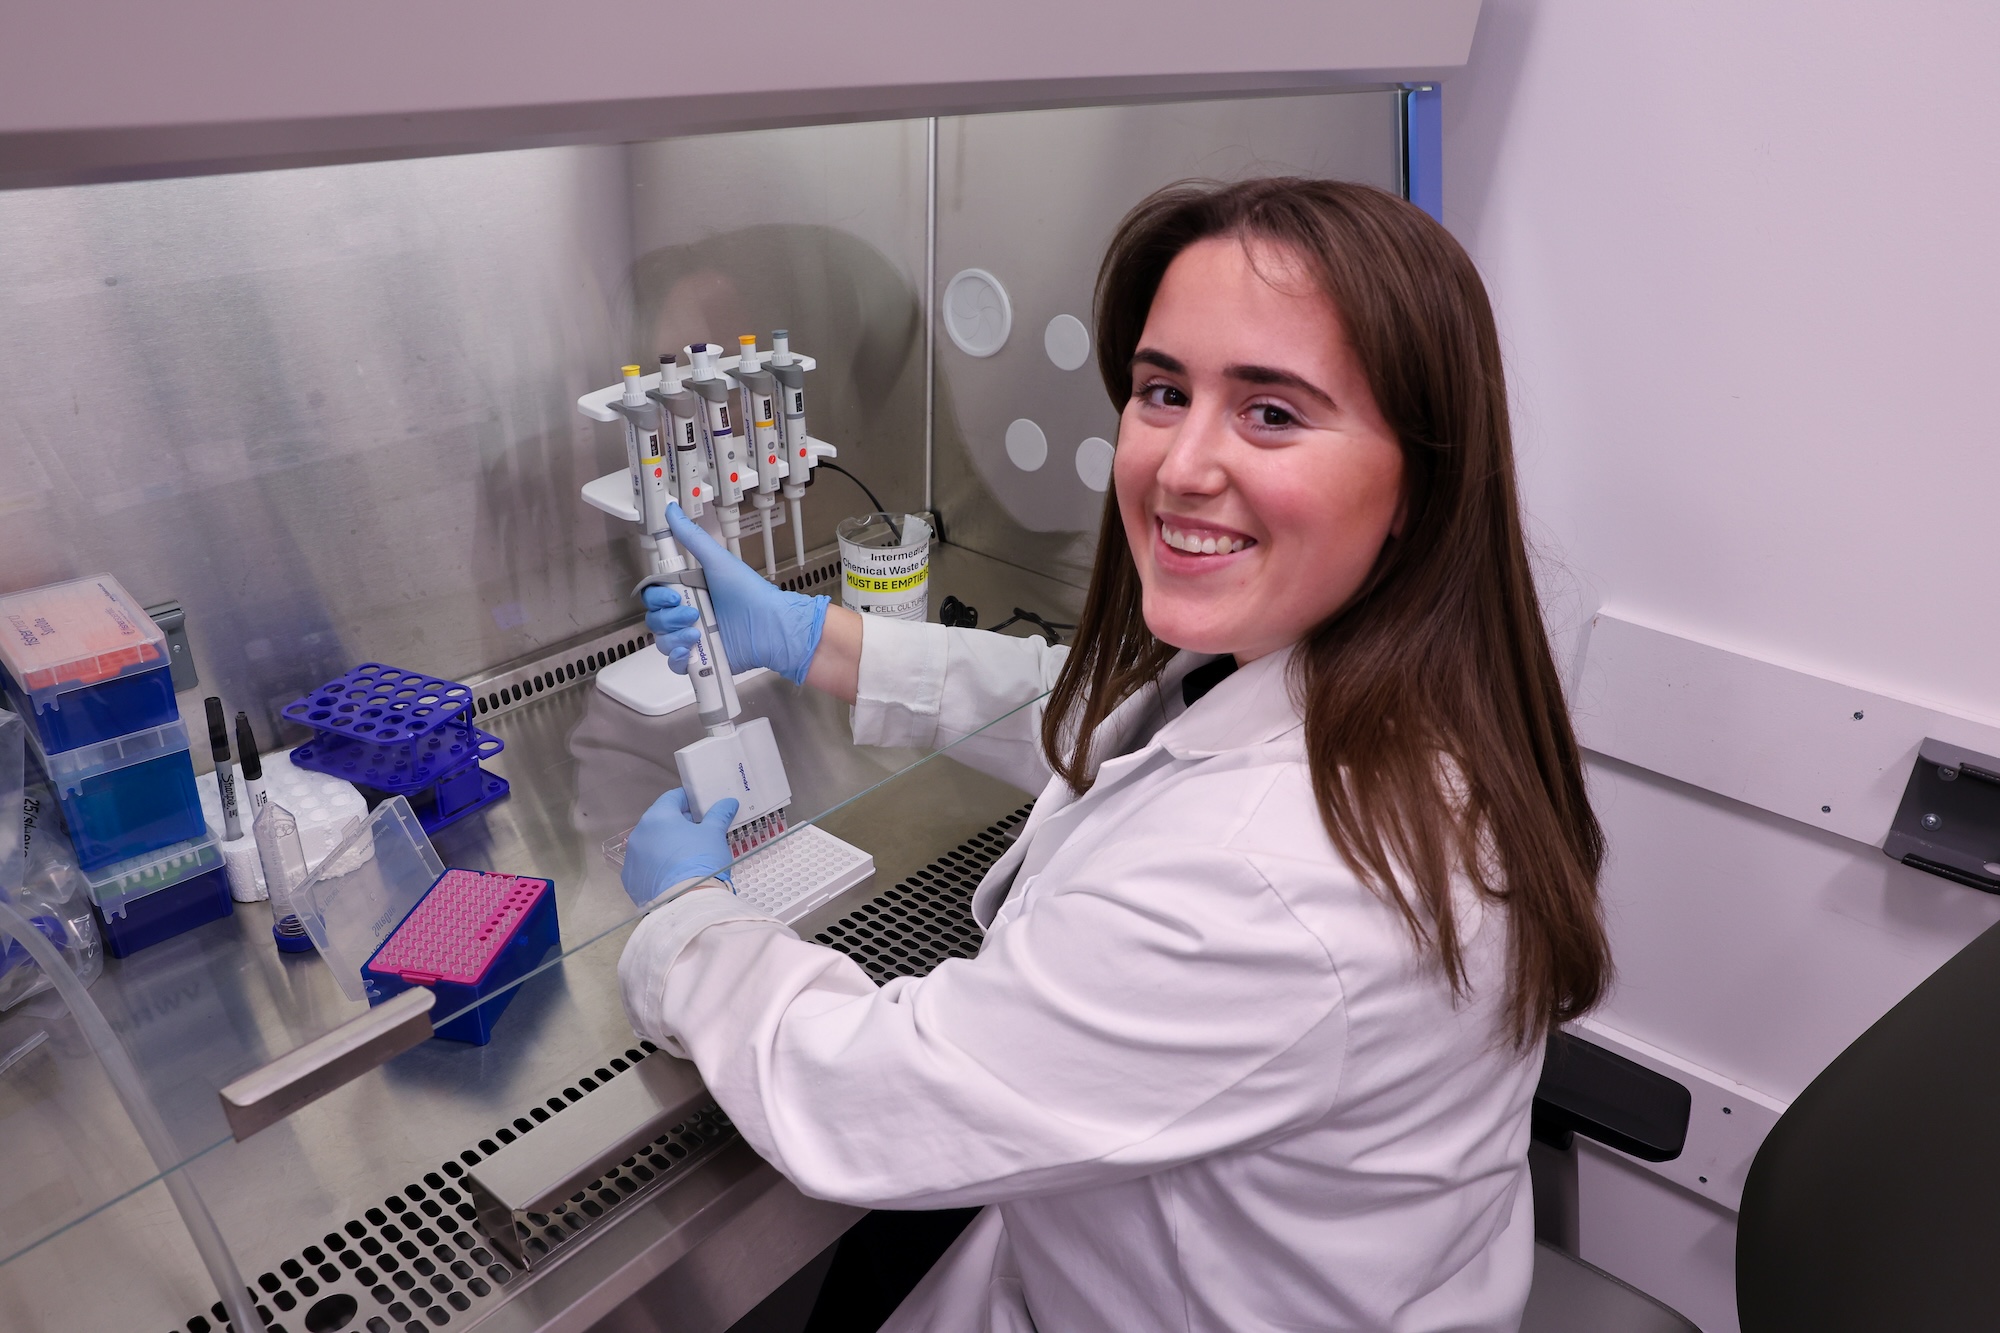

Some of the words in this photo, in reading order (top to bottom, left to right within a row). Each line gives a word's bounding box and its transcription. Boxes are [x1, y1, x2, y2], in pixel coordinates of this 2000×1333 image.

[703, 429, 712, 460] eppendorf
[842, 557, 887, 576] Chemical
[889, 562, 919, 576] Waste
[847, 573, 871, 589] MUST
[874, 581, 888, 590] BE
[738, 762, 750, 792] eppendorf
